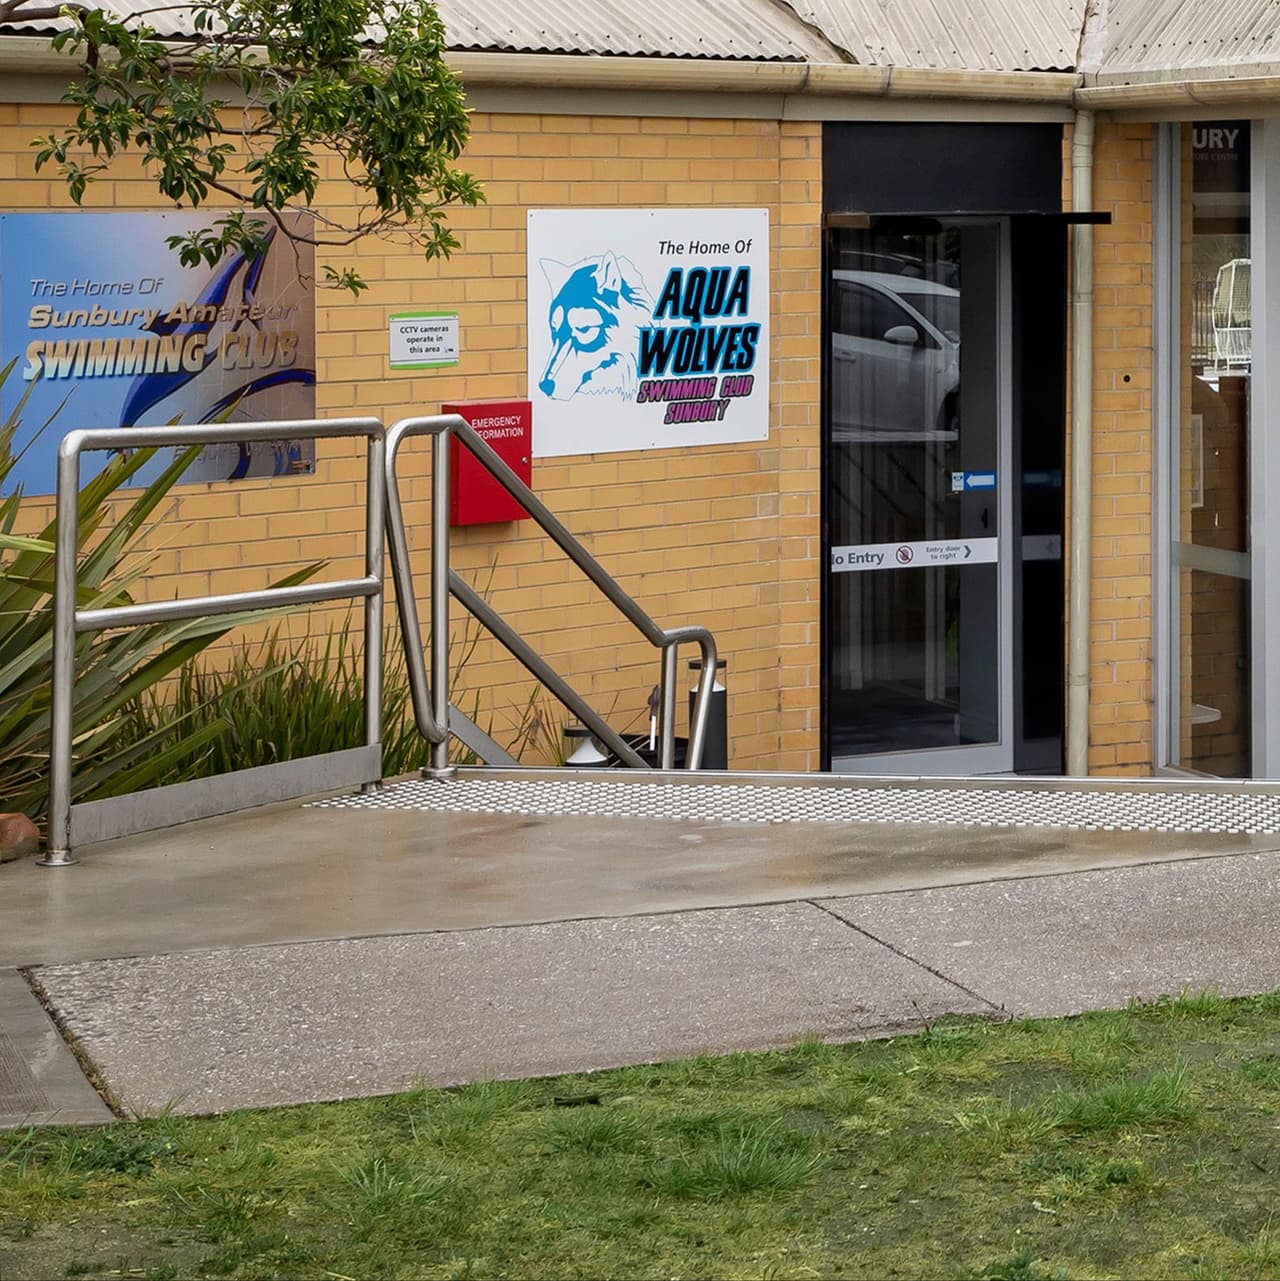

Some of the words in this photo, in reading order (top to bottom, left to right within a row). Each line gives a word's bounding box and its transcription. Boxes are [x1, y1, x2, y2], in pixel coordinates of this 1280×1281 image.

[658, 240, 684, 255] The
[689, 240, 730, 255] Home
[735, 239, 752, 254] Of
[30, 278, 68, 298] The
[71, 278, 133, 297] Home
[138, 277, 164, 295] Of
[652, 265, 752, 325] AQUA
[27, 303, 161, 330] Sunbury
[164, 300, 299, 324] Amateur
[400, 326, 419, 334] CCTV
[406, 336, 434, 344] operate
[24, 331, 209, 381] SWIMMING
[222, 330, 300, 371] CLUB
[409, 346, 423, 354] this
[637, 323, 762, 379] WOLVES
[636, 376, 718, 403] SWIMMING
[720, 375, 754, 399] CLUB
[664, 399, 730, 425] SUNBURY
[471, 415, 521, 429] EMERGENCY
[479, 427, 524, 440] FORMATION
[926, 545, 944, 554] Entry
[945, 544, 961, 552] door
[848, 552, 885, 566] Entry
[940, 553, 956, 561] right
